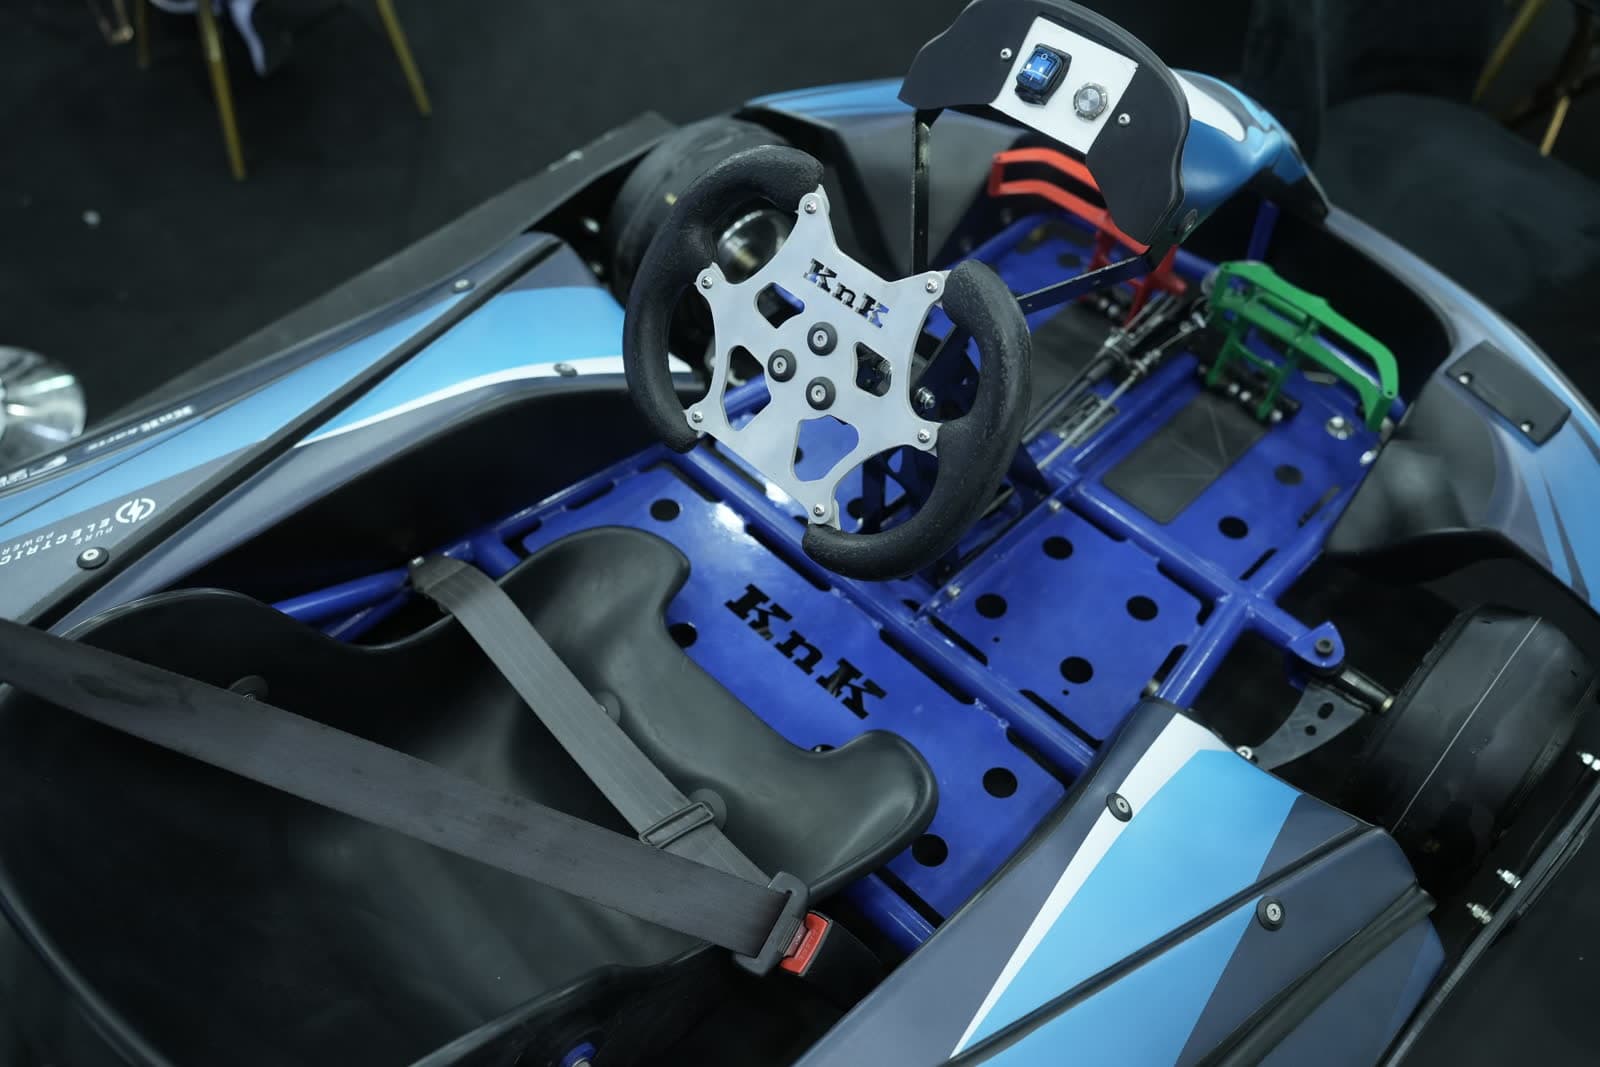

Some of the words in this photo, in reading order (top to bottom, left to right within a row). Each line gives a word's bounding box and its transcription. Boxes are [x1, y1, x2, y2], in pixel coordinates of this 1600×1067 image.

[803, 258, 890, 328] KnK
[0, 517, 110, 565] ELECTRIC
[2, 531, 54, 555] POWER
[75, 526, 113, 546] PURE
[725, 583, 888, 720] KnK
